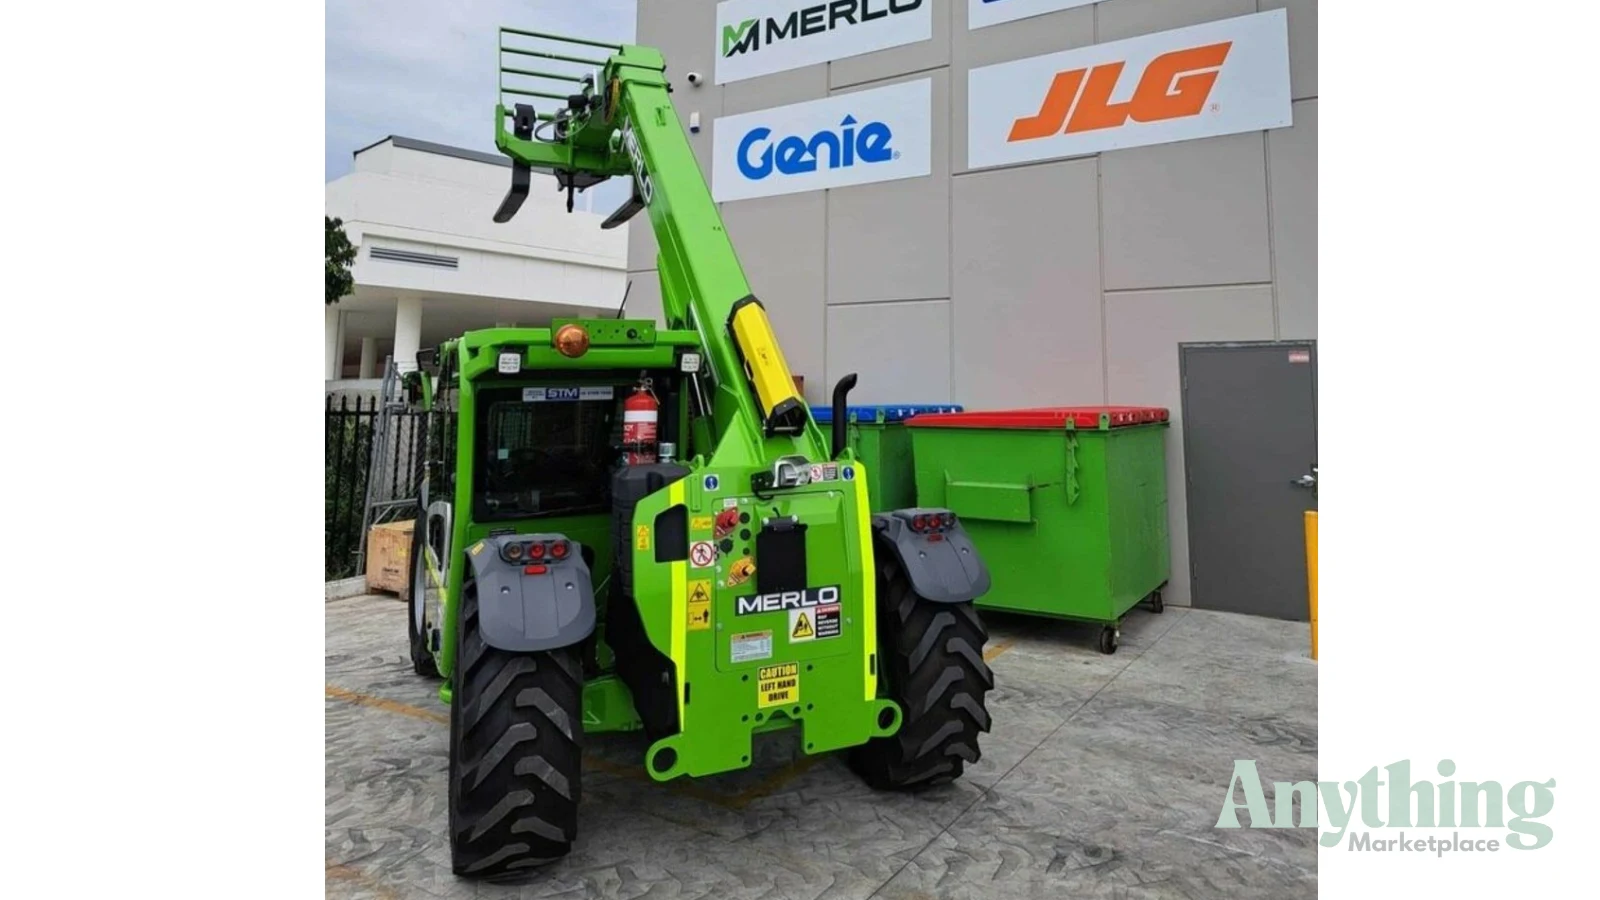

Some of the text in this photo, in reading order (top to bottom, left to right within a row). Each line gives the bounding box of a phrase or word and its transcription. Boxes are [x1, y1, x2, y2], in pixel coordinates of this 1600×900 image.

[1006, 41, 1233, 143] JLG
[737, 115, 892, 180] Genie
[548, 388, 578, 398] STM
[738, 587, 838, 614] MERLO
[761, 664, 797, 680] CAUTION
[761, 679, 796, 692] LEFT HAND
[768, 691, 788, 702] DRIVE
